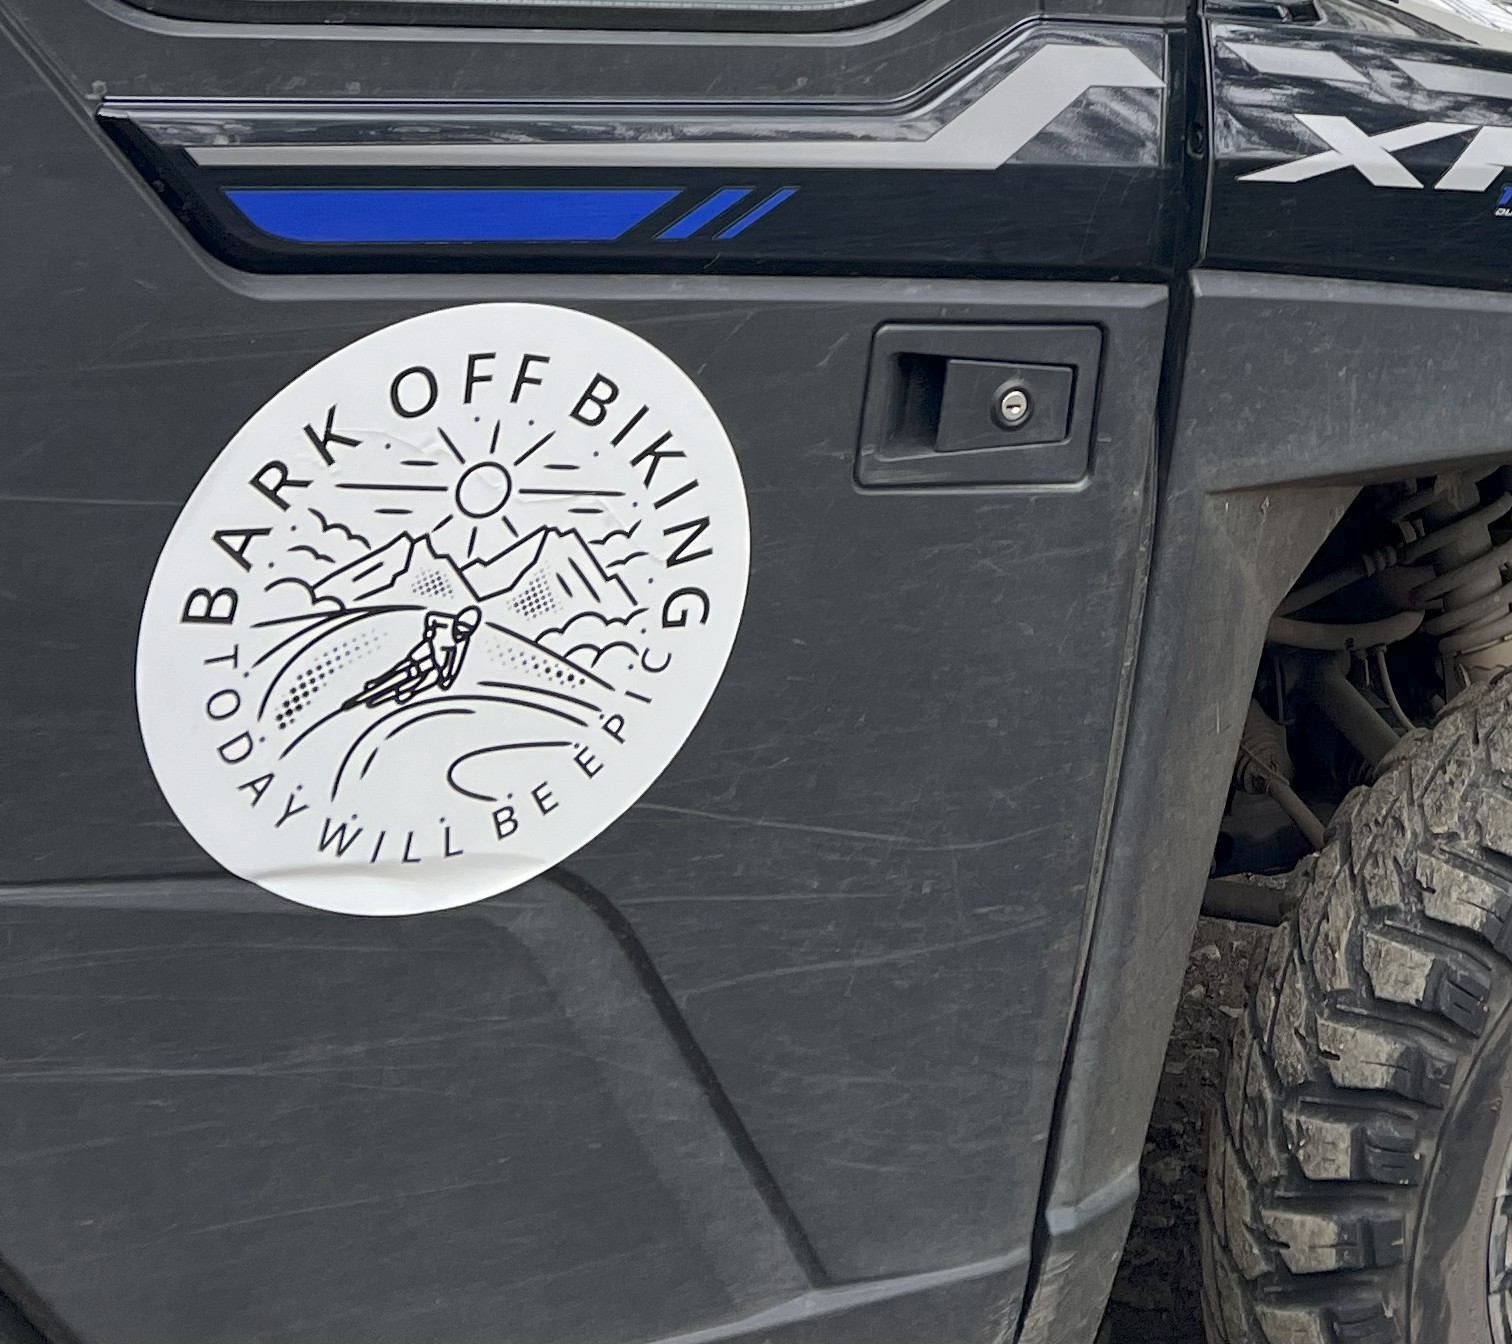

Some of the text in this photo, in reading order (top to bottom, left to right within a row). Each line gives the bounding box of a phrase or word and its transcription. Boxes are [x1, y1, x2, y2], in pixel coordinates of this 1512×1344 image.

[180, 352, 713, 630] BARK OFF BIKING
[202, 642, 673, 864] TODAY WILL BE EPIC
